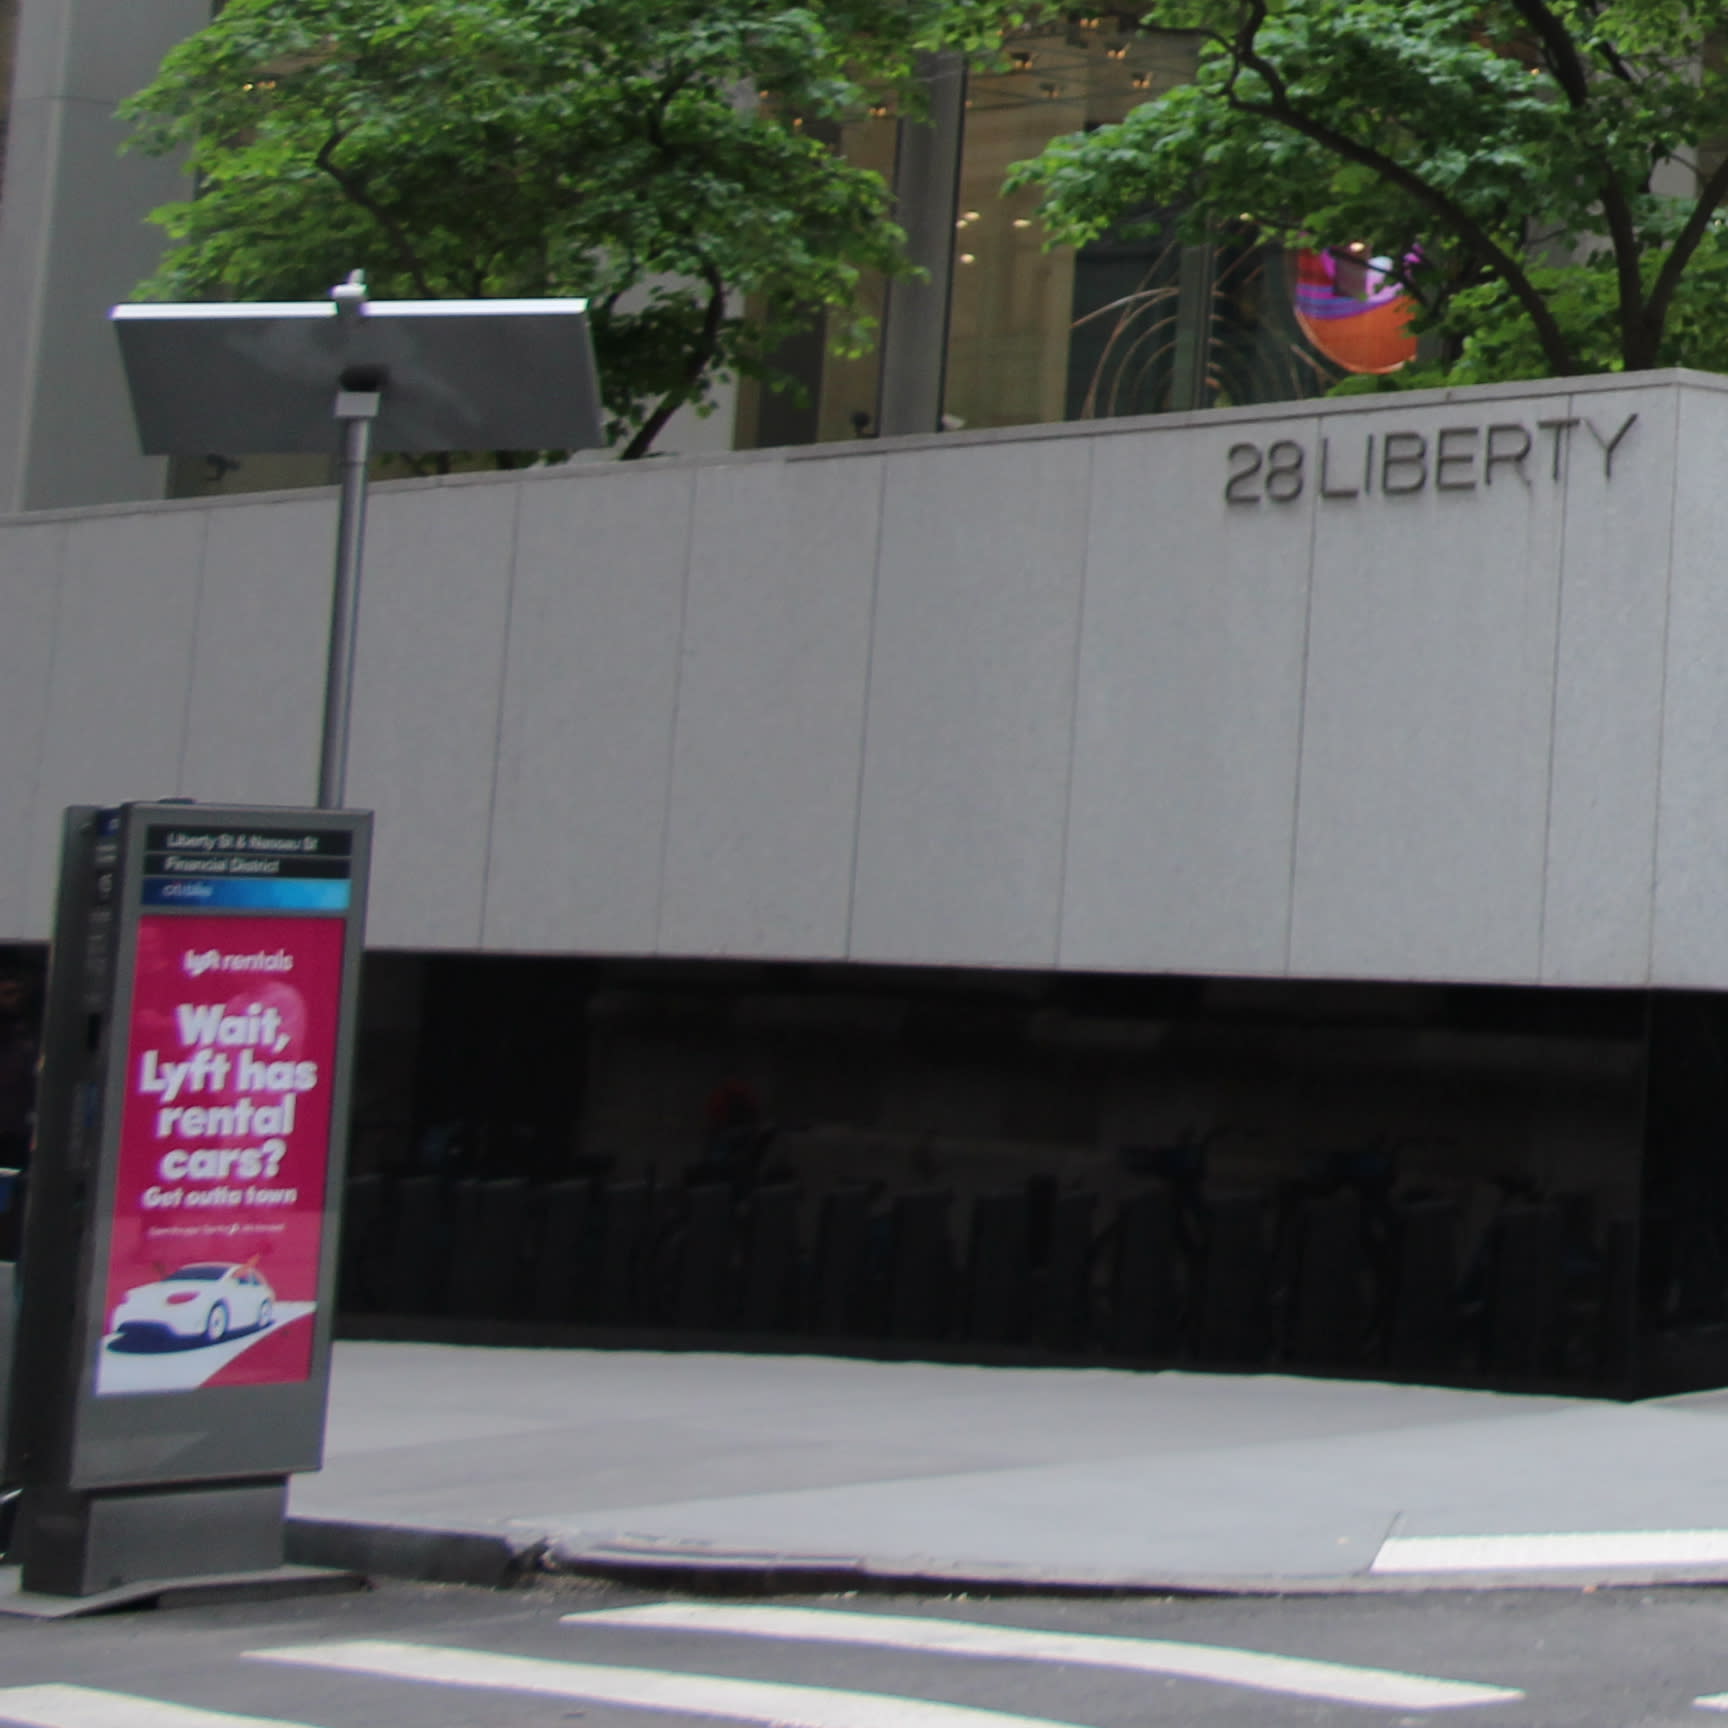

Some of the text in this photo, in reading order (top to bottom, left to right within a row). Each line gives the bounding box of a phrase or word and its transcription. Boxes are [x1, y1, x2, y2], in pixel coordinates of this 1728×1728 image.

[1225, 413, 1639, 504] 28 LIBERTY
[166, 832, 215, 851] Liberty
[218, 833, 233, 849] St
[249, 835, 300, 850] Nassau
[164, 856, 281, 873] Financial District
[183, 949, 294, 978] lyft rentals
[176, 1003, 290, 1053] Wait,
[140, 1048, 318, 1103] Lyft has
[156, 1093, 297, 1139] rental
[160, 1139, 287, 1179] cars?
[142, 1186, 297, 1208] Get outta town
